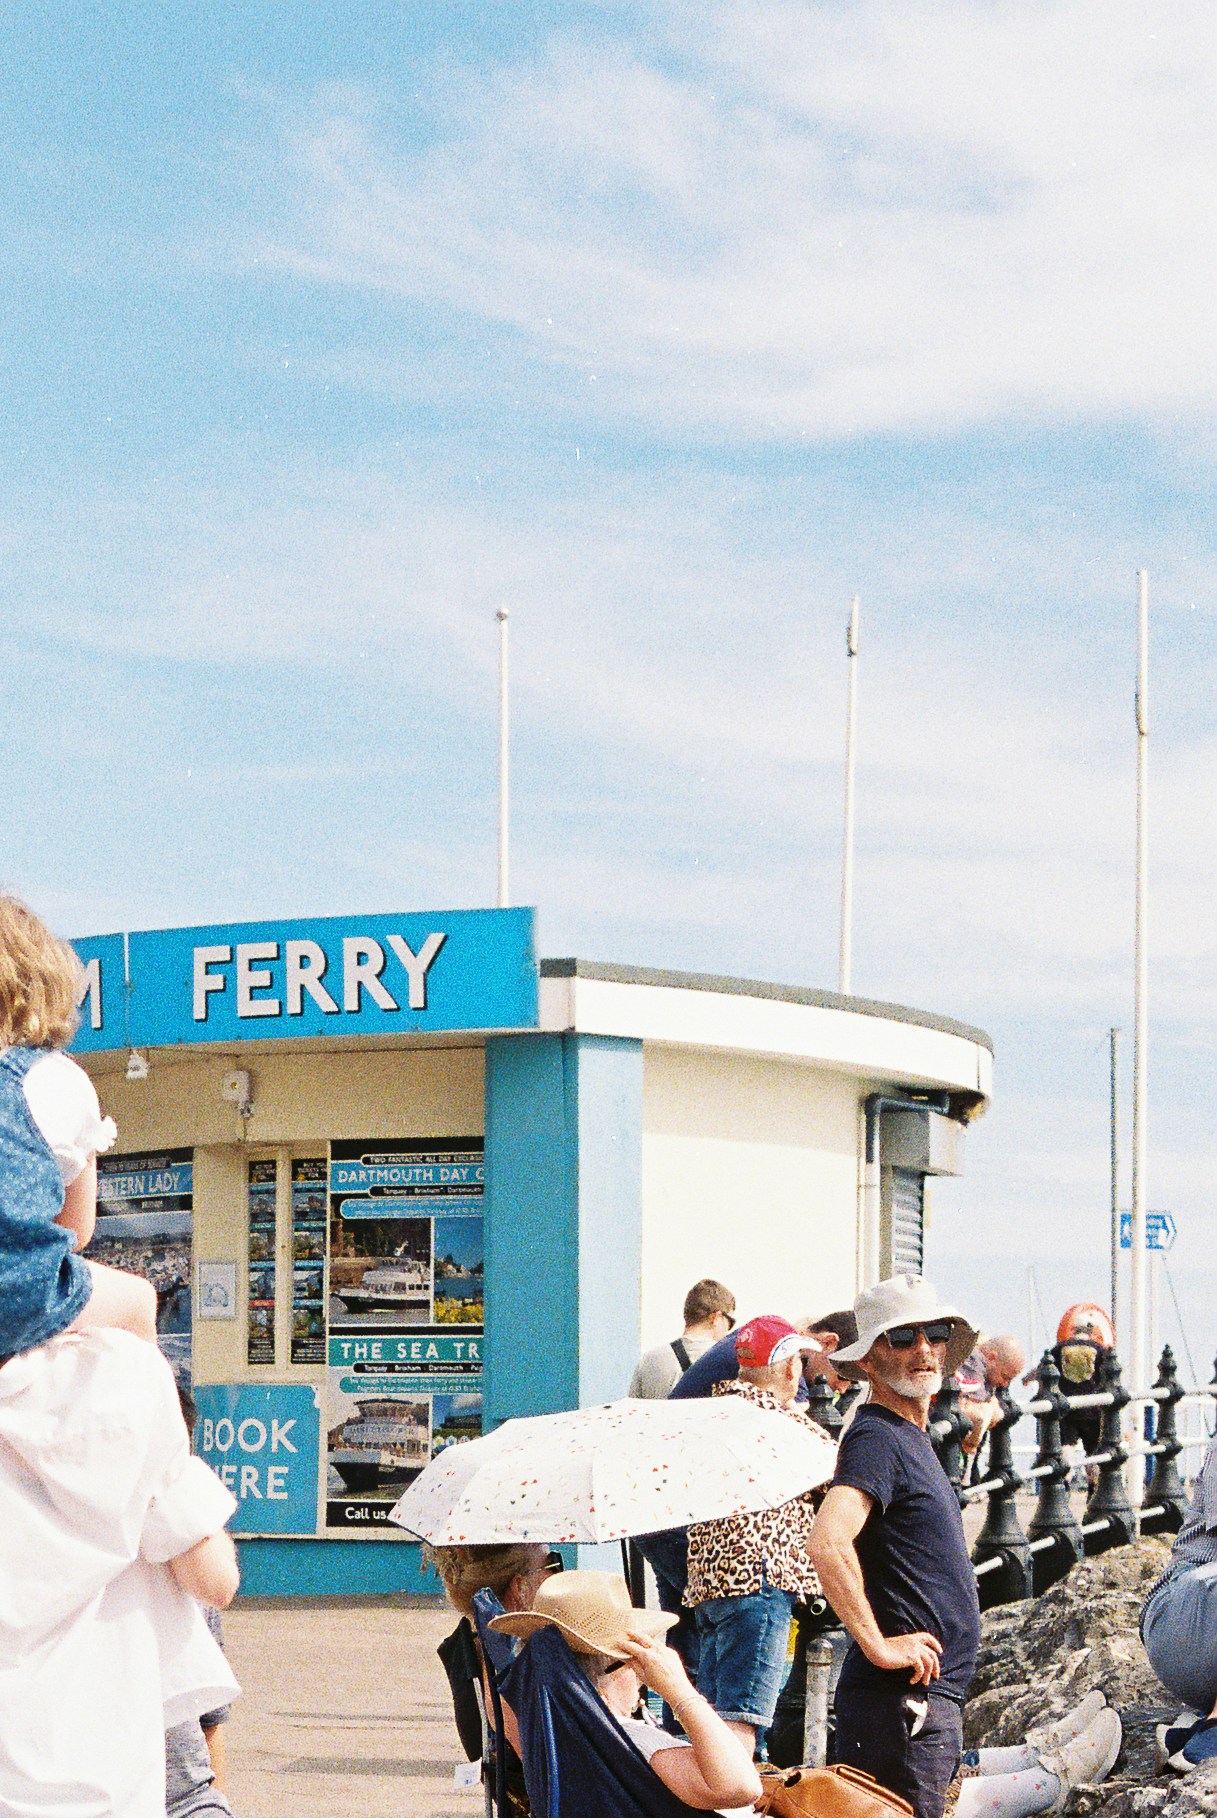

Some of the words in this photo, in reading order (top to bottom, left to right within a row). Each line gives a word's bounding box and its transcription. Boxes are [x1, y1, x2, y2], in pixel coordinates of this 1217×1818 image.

[192, 932, 447, 1022] FERRY
[388, 1155, 422, 1163] FANTASTIC
[149, 1171, 180, 1193] LADY
[337, 1168, 433, 1184] DARTMOUTH
[440, 1167, 469, 1182] DAY
[341, 1342, 383, 1360] THE
[397, 1341, 439, 1359] SEA
[453, 1341, 480, 1359] TR
[203, 1418, 298, 1453] BOOK
[215, 1465, 289, 1500] ERE
[345, 1506, 370, 1520] Call
